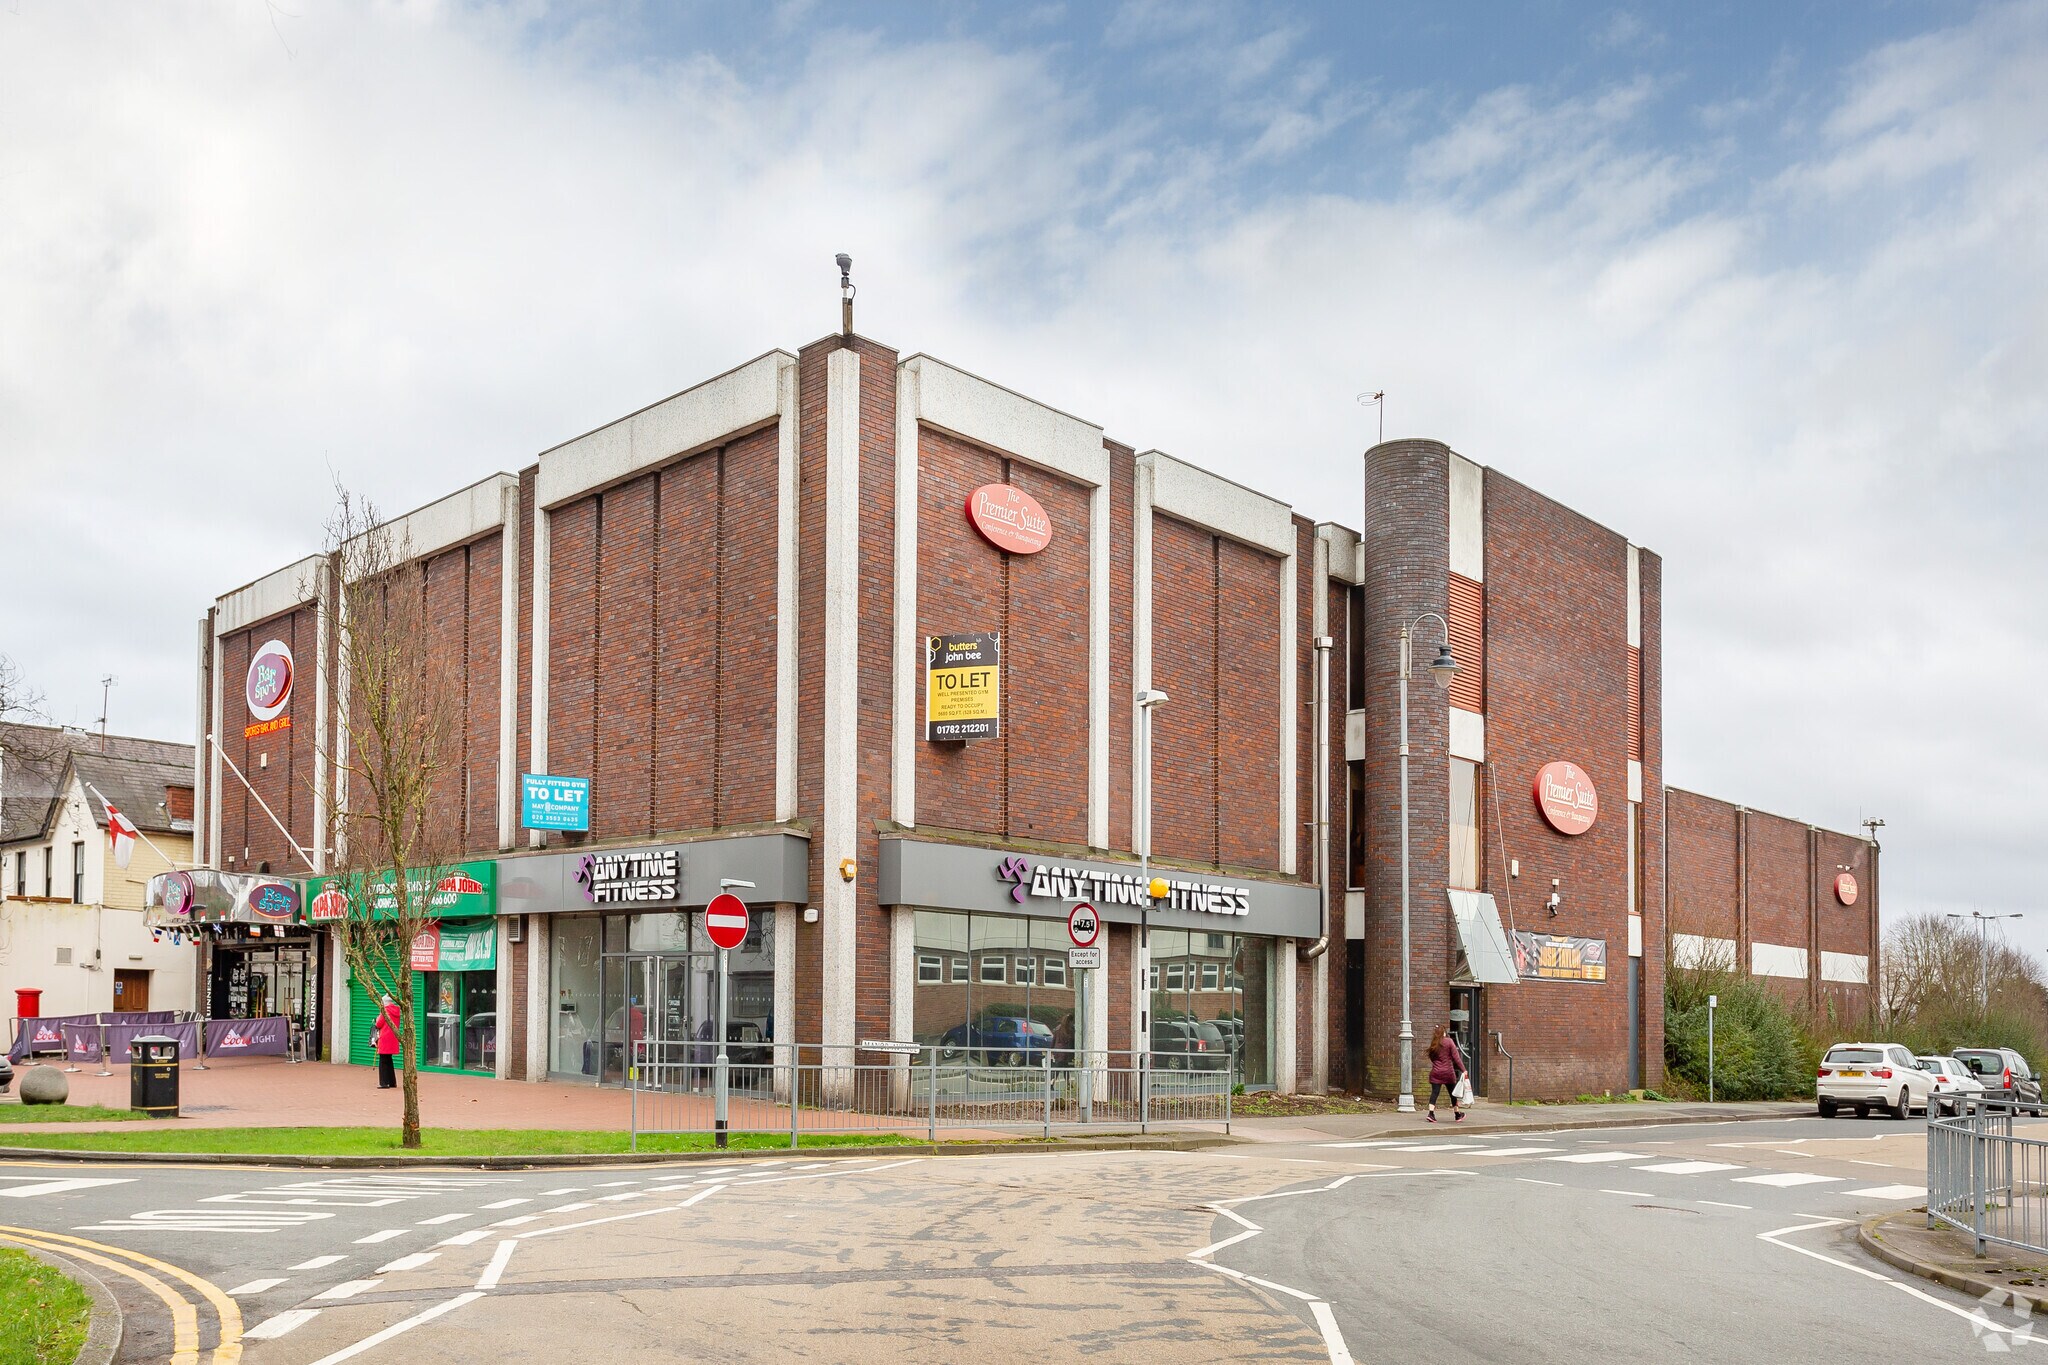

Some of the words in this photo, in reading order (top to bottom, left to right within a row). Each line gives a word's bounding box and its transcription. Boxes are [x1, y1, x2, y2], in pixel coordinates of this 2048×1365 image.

[1006, 488, 1020, 503] The
[978, 492, 1018, 522] Premier
[1016, 506, 1046, 532] Suite
[982, 520, 1008, 536] Conference
[1014, 531, 1042, 548] Banqueting
[948, 642, 978, 652] butters
[944, 652, 964, 664] john
[966, 652, 982, 660] bee
[257, 664, 277, 686] Bar
[936, 674, 957, 690] TO
[960, 672, 990, 688] LET
[936, 726, 960, 734] 01782
[962, 724, 989, 733] 212201
[1564, 764, 1576, 780] The
[528, 786, 550, 800] TO
[554, 788, 584, 803] LET
[1544, 774, 1574, 803] Premier
[1573, 782, 1594, 809] Suite
[592, 850, 676, 880] ANYTIME
[457, 878, 482, 894] JOHNS
[594, 879, 676, 902] FITNESS
[1030, 864, 1151, 906] ANYTIME
[1166, 879, 1250, 916] ITNESS
[264, 888, 292, 907] Bar
[443, 893, 457, 904] 600
[222, 1034, 251, 1045] Coors
[252, 1035, 276, 1043] LIGHT
[71, 1209, 336, 1232] NO
